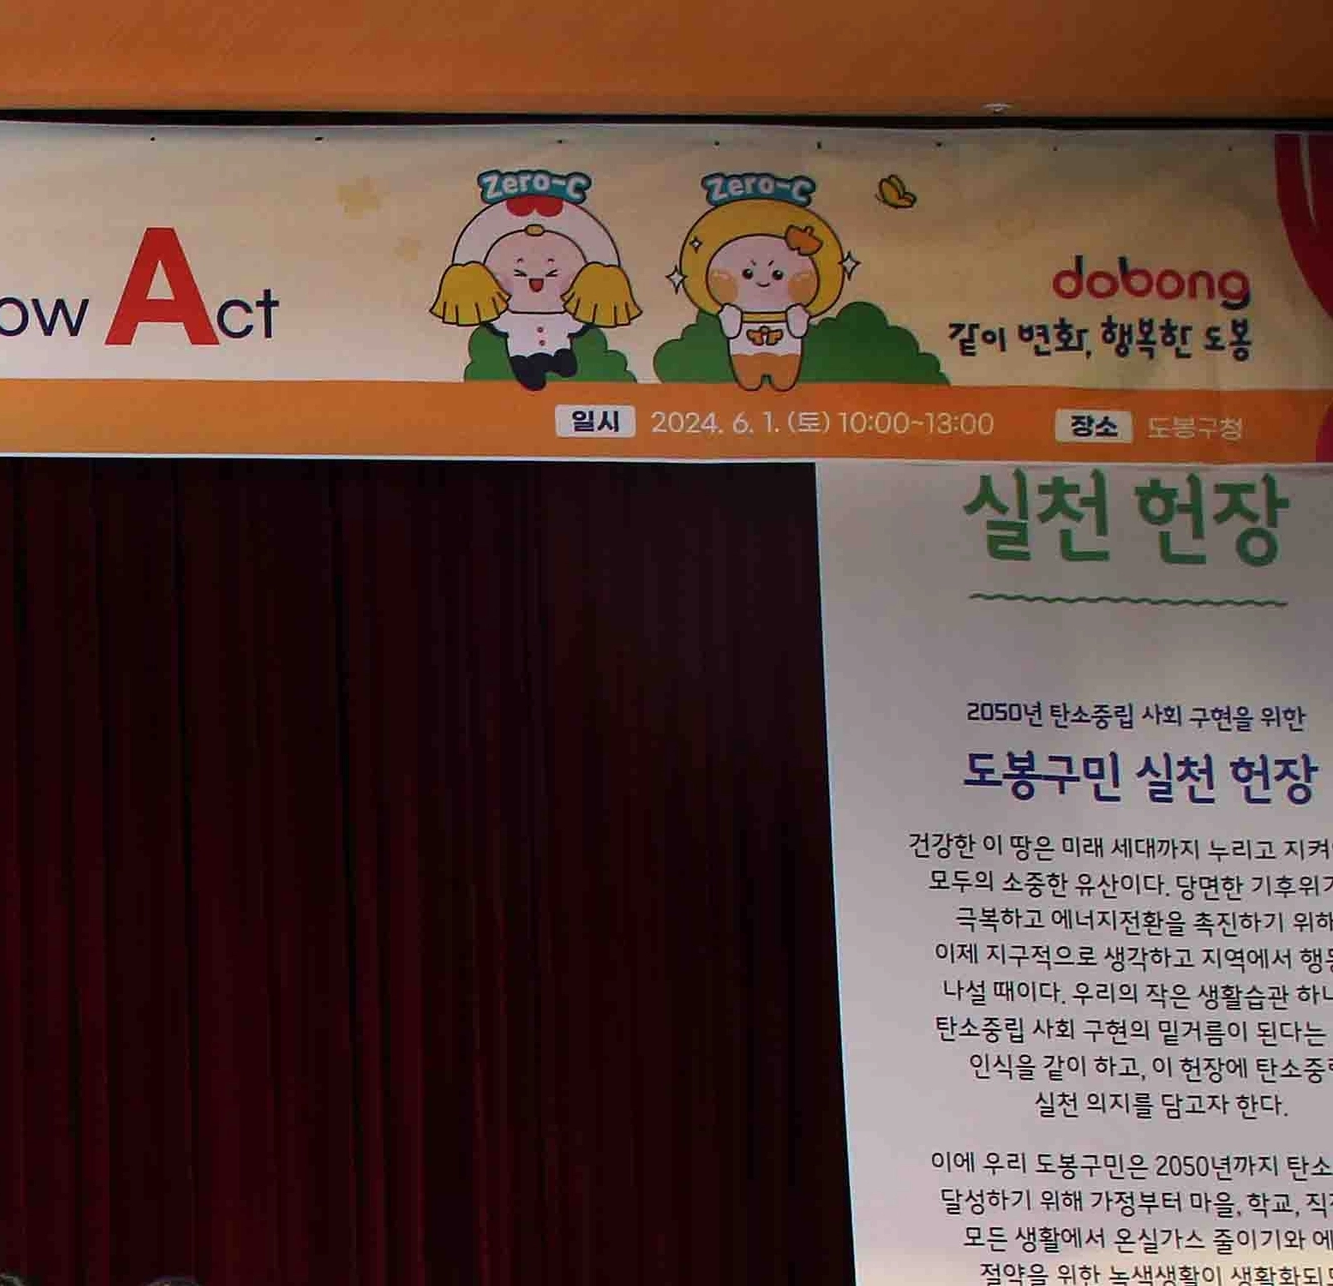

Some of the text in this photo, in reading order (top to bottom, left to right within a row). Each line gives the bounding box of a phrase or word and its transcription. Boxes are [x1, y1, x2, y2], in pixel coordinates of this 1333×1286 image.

[482, 173, 588, 199] Zero-C
[706, 177, 813, 201] Zero-C
[104, 227, 280, 346] Act
[1052, 254, 1252, 312] dobong
[948, 314, 1253, 362] 같이 변화, 행복한 도봉
[571, 410, 620, 433] 일시
[651, 411, 994, 435] 2024. 6. 1. (토) 10:00~13:00
[1070, 415, 1118, 438] 장소
[1148, 417, 1243, 440] 도봉구청
[962, 467, 1291, 568] 실천 헌장
[967, 700, 1307, 733] 2050년 탄소중립 사회 구현을 위한
[963, 749, 1320, 805] 도봉구민 실천 헌장
[909, 832, 1330, 863] 건강한 이 땅은 미래 세대까지 누리고 지켜
[928, 870, 994, 894] 모두의
[1002, 871, 1069, 899] 소중한
[1074, 873, 1170, 899] 유산이다.
[1176, 875, 1244, 901] 당면한
[955, 907, 1284, 938] 극복하고 에너지전환을 촉진하기
[935, 942, 979, 965] 이제
[986, 943, 1098, 971] 지구적으로
[1104, 946, 1195, 973] 생각하고
[1201, 947, 1292, 974] 지역에서
[943, 979, 1290, 1011] 나설 때이다. 우리의 작은 생활습관
[935, 1015, 1327, 1047] 탄소중립 사회 구현의 밑거름이 된다는
[969, 1053, 1036, 1081] 인식을
[1043, 1055, 1086, 1082] 같이
[1093, 1055, 1146, 1081] 하고,
[1152, 1056, 1172, 1078] 이
[1178, 1056, 1248, 1084] 헌장에
[1034, 1091, 1288, 1120] 실천 의지를 담고자 한다.
[931, 1151, 975, 1173] 이에
[982, 1152, 1027, 1176] 우리
[1035, 1153, 1149, 1180] 도봉구민은
[1155, 1155, 1279, 1182] 2050년까지
[941, 1188, 1333, 1219] 달성하기 위해 가정부터 마을, 학교, 직
[963, 1226, 1008, 1253] 모든
[1015, 1226, 1105, 1254] 생활에서
[1113, 1227, 1206, 1255] 온실가스
[1212, 1228, 1307, 1256] 줄이기와
